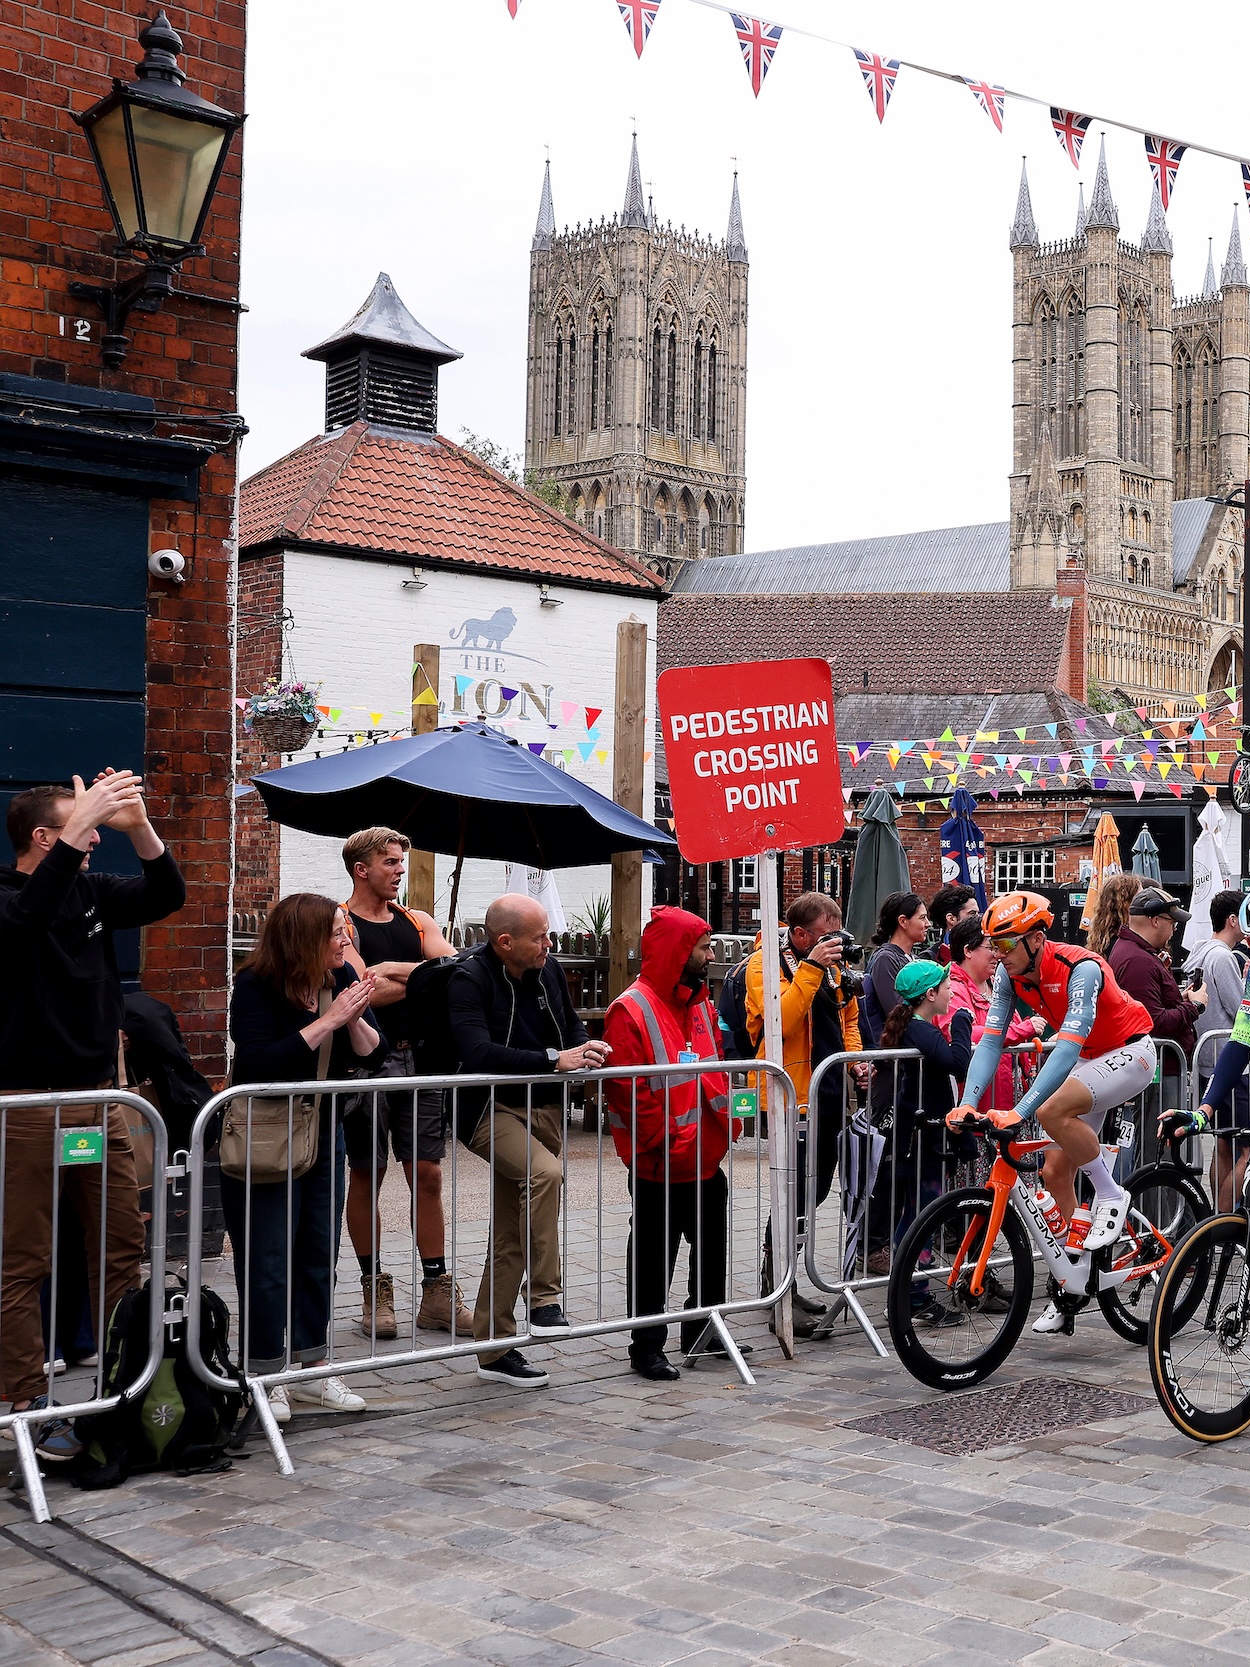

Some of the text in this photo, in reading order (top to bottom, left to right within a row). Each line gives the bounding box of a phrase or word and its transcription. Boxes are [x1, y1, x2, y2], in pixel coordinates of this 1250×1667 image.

[59, 315, 91, 342] 12
[460, 654, 506, 673] THE
[438, 675, 554, 724] ION
[670, 701, 830, 742] PEDESTRIAN
[693, 739, 819, 778] CROSSING
[724, 778, 801, 813] POINT
[1070, 977, 1085, 1015] INEOS
[1093, 1050, 1134, 1079] INEOS
[1119, 1125, 1132, 1142] 24
[957, 1199, 992, 1208] SCOPE
[1180, 1178, 1204, 1205] SCOPE
[1114, 1306, 1139, 1332] SCOPE
[940, 1370, 977, 1381] SCOPE
[1162, 1350, 1196, 1418] roval
